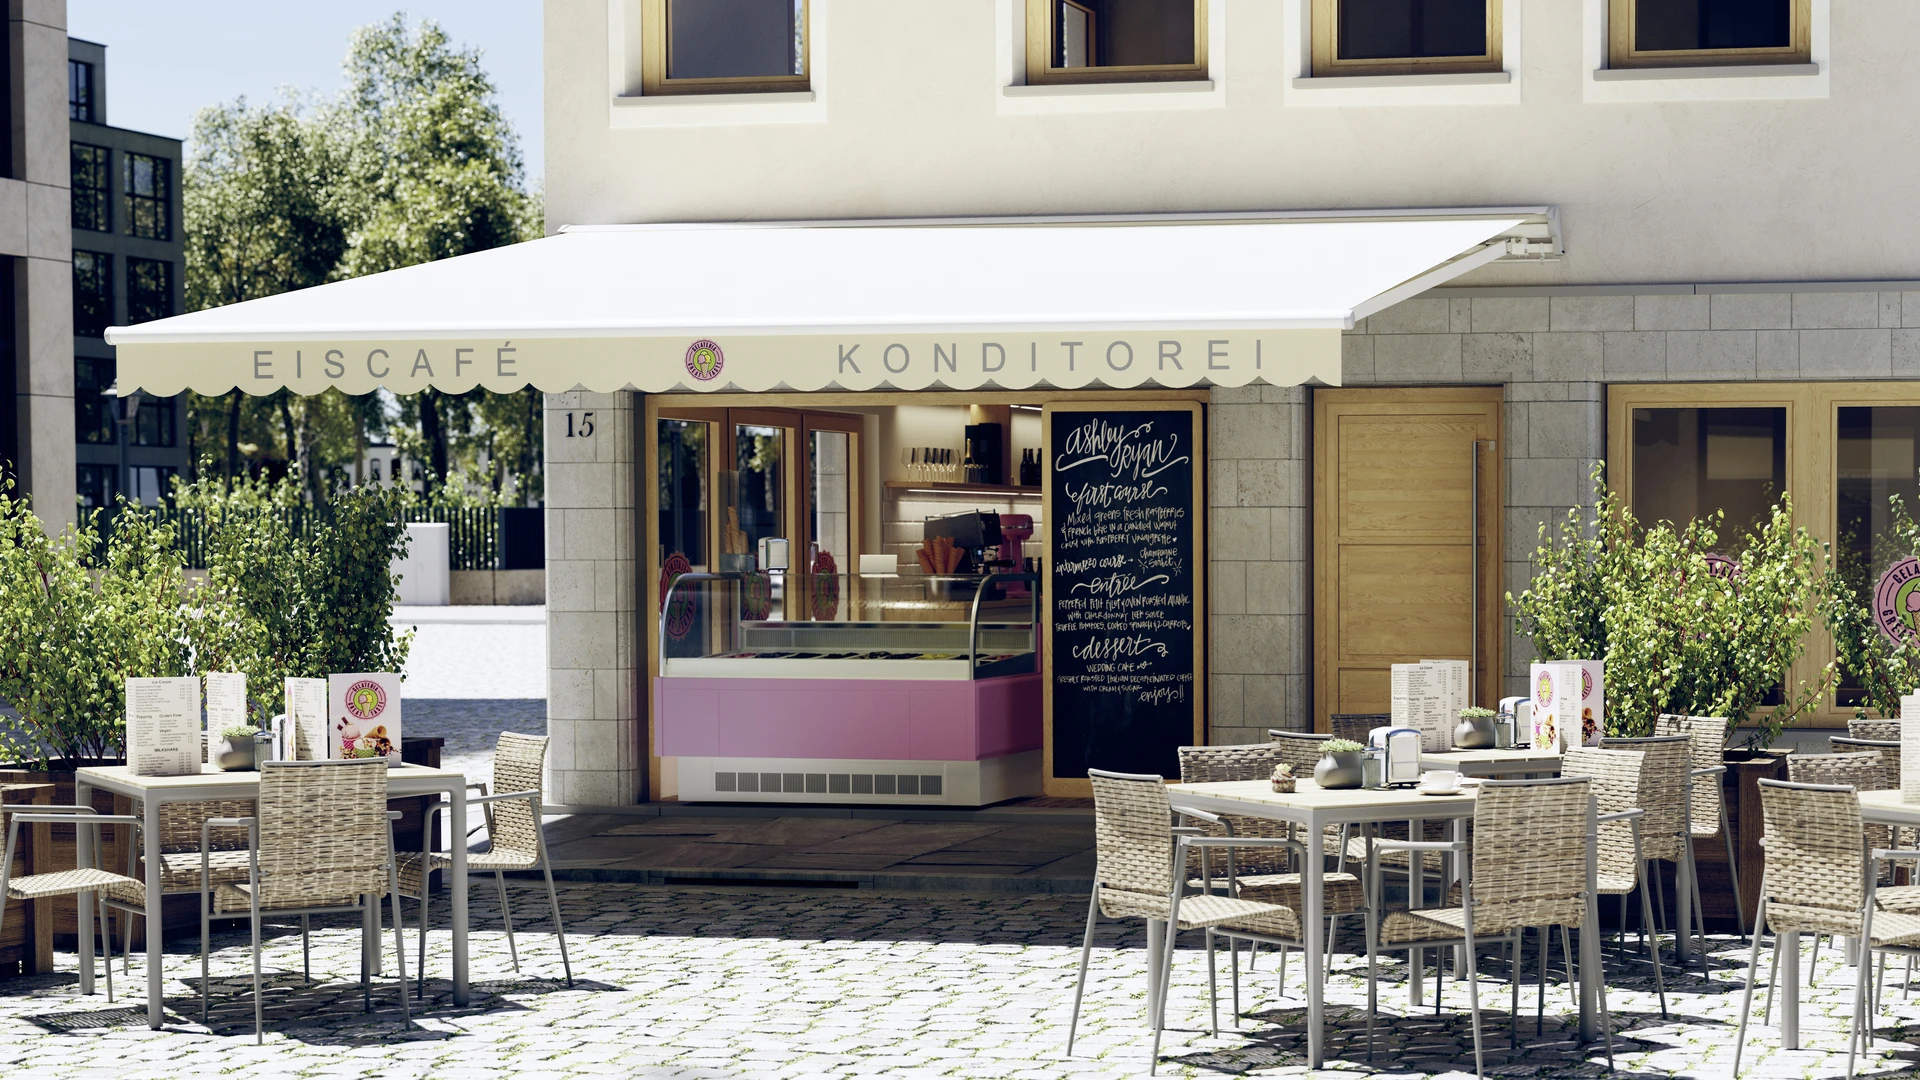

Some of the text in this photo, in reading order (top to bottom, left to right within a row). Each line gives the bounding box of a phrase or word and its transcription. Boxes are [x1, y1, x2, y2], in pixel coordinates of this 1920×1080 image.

[254, 341, 517, 379] EISCAFÉ
[838, 339, 1261, 374] KONDITOREI
[565, 412, 594, 438] 15
[1065, 480, 1167, 514] first course
[1073, 634, 1163, 661] dessert
